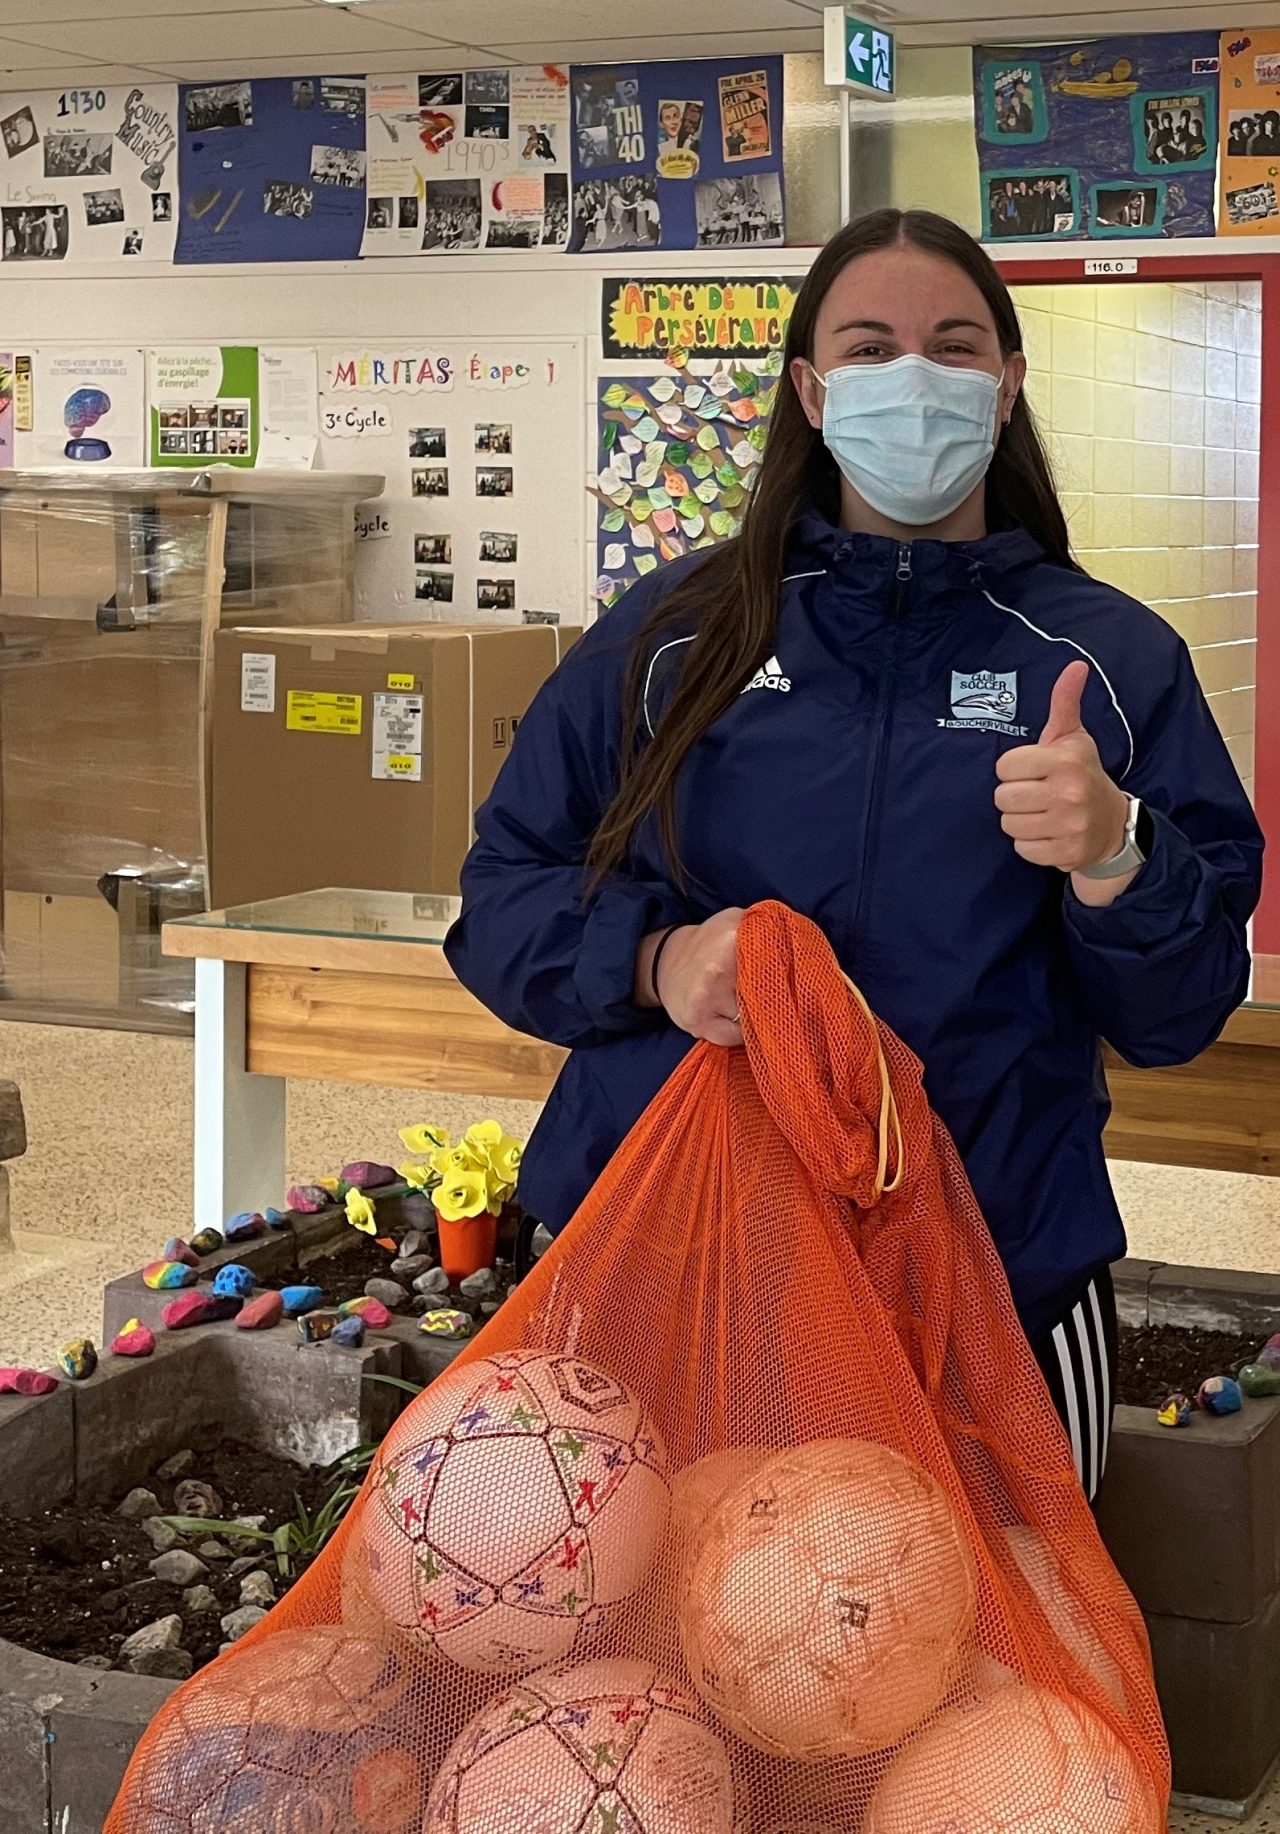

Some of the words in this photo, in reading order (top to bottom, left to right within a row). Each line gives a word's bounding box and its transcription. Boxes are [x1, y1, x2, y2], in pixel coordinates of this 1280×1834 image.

[734, 74, 755, 87] APRIL
[57, 90, 106, 118] 1930
[725, 98, 767, 124] MILLER
[124, 88, 176, 148] Country
[115, 115, 159, 166] Music
[6, 182, 22, 202] Le
[624, 285, 695, 314] Arbre
[756, 286, 780, 310] la
[157, 369, 169, 377] au
[169, 366, 210, 378] gaspillage
[332, 353, 451, 388] MÉRITAS
[470, 353, 528, 385] Étape
[157, 378, 199, 389] d'énergie!
[345, 410, 387, 433] Cycle
[354, 515, 390, 538] ycle
[740, 674, 792, 694] das
[959, 681, 1007, 691] SOCCER
[971, 673, 996, 681] CLUB
[947, 720, 1019, 737] BOUCHERVILLE
